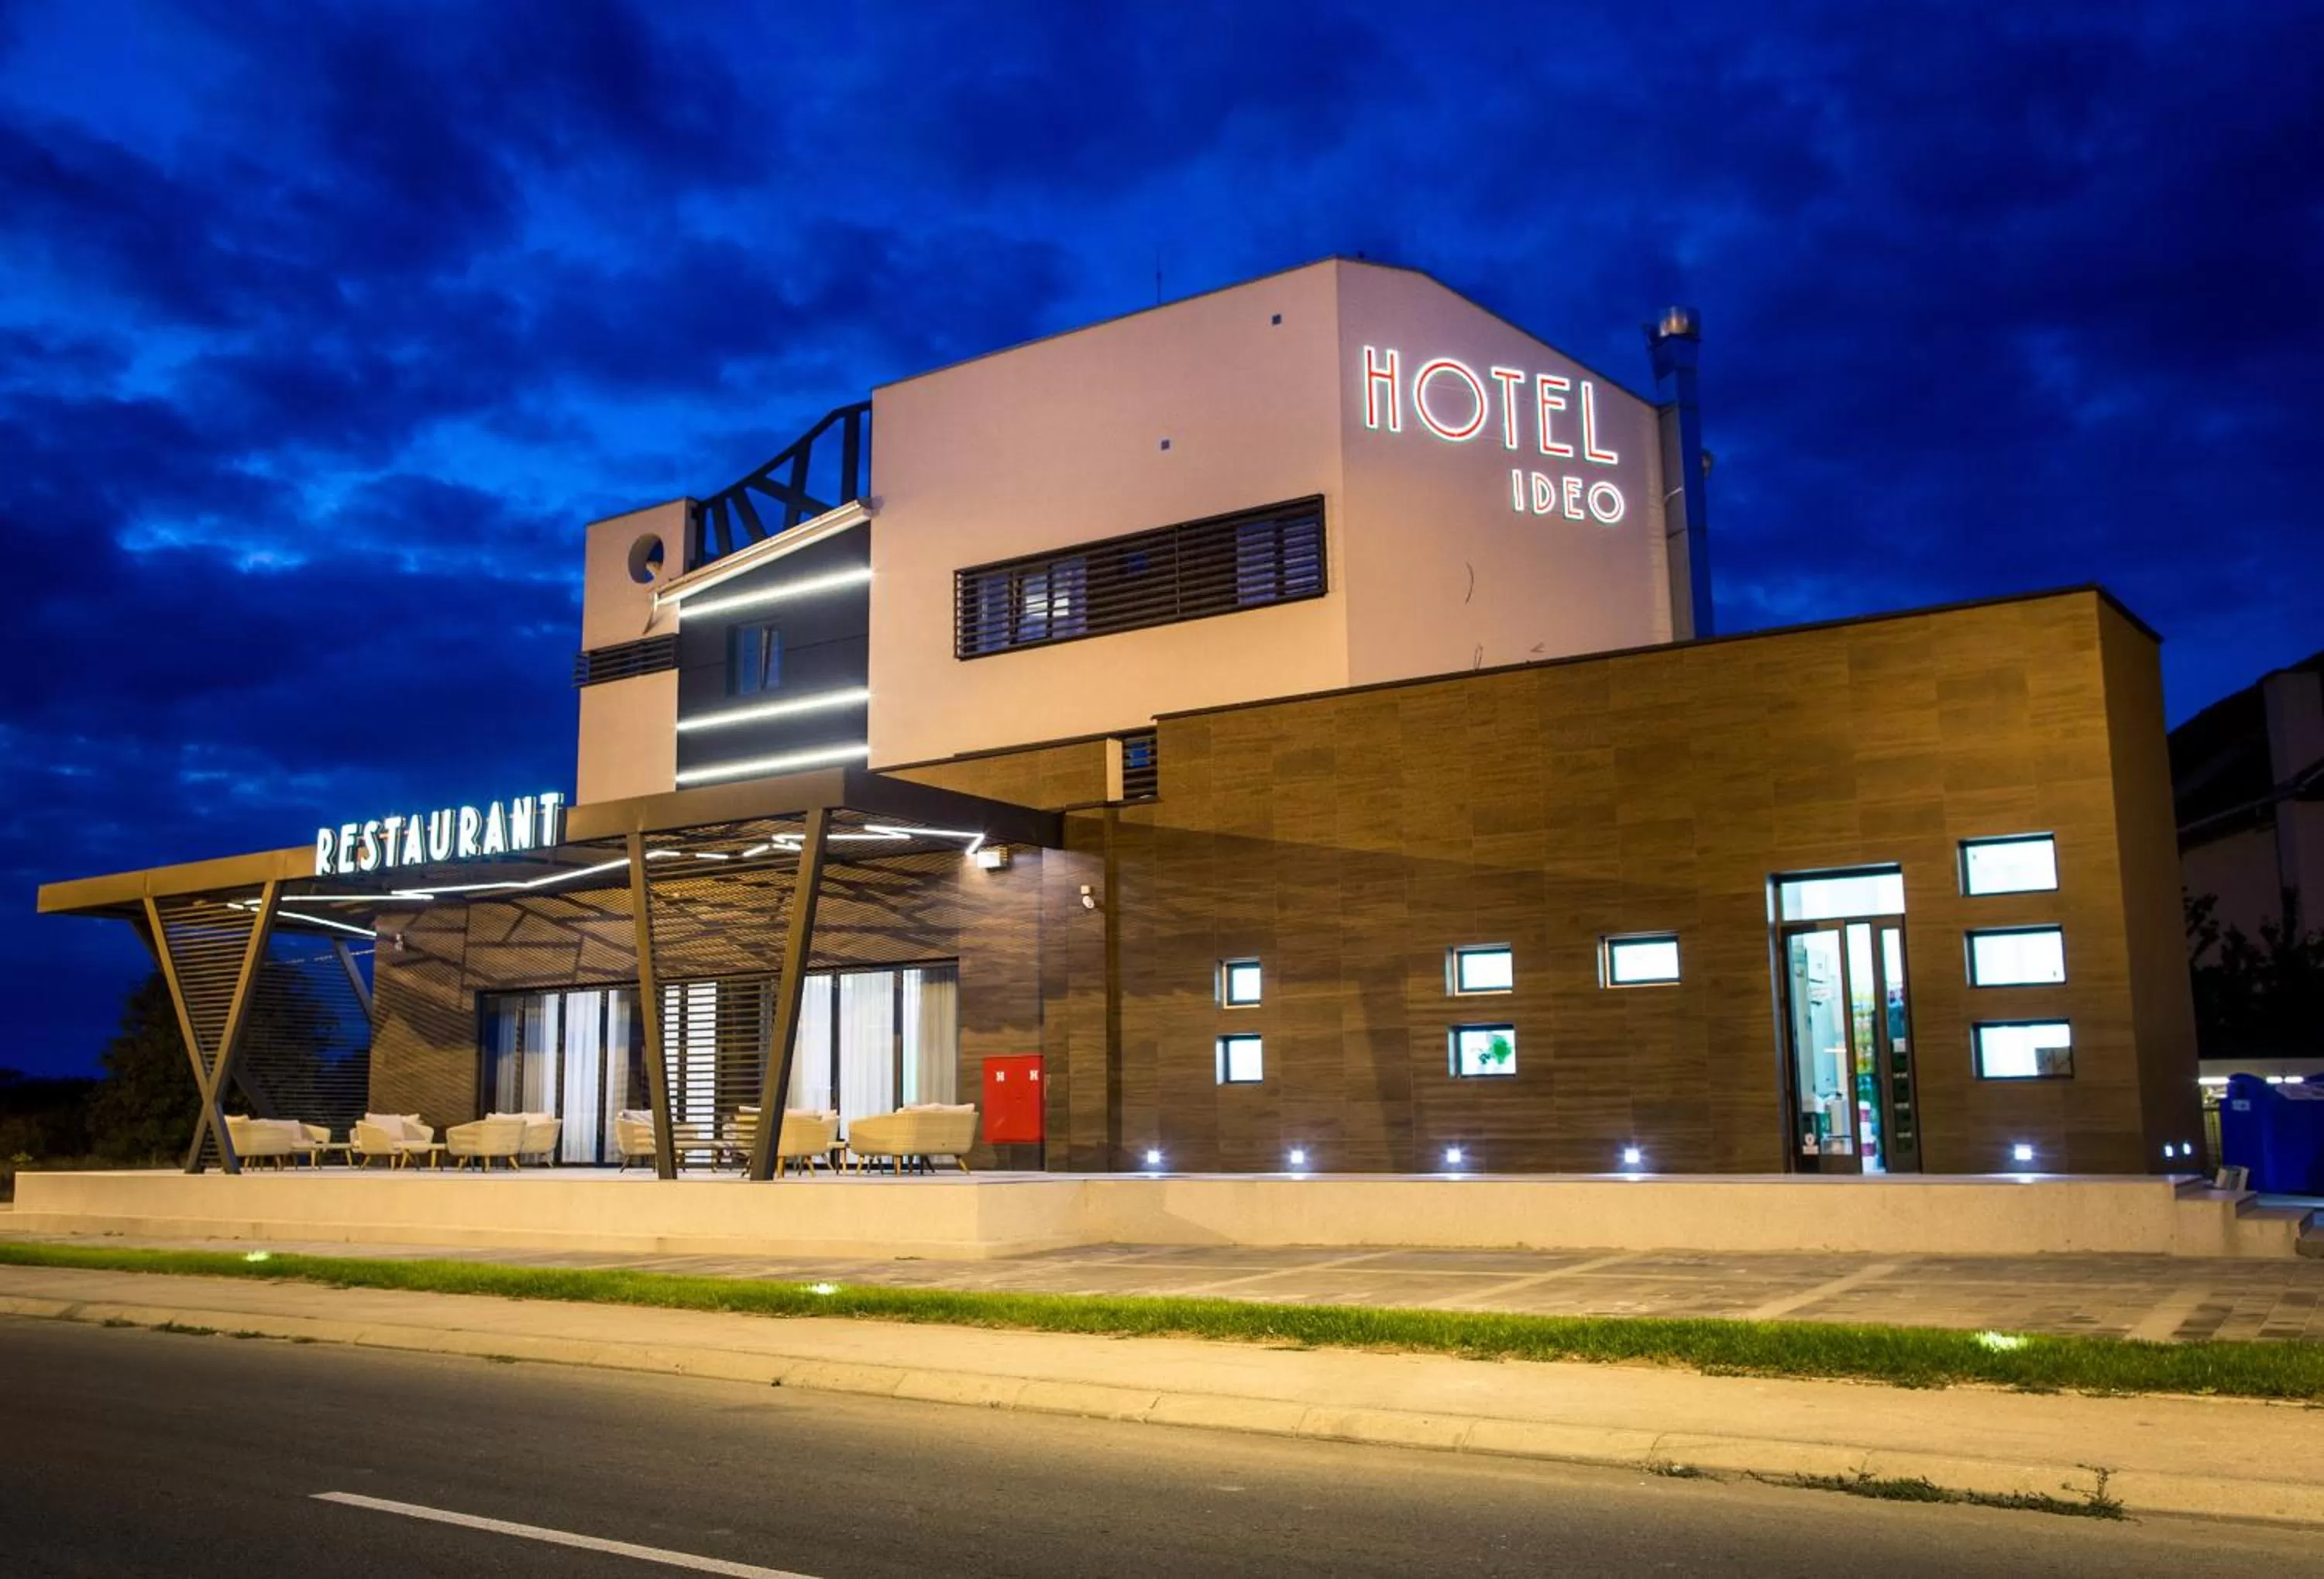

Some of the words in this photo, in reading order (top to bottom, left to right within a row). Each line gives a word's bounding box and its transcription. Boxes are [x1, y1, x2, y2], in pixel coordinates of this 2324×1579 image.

[1363, 346, 1618, 465] HOTEL
[1511, 469, 1624, 524] IDEO
[315, 793, 565, 876] RESTAURANT
